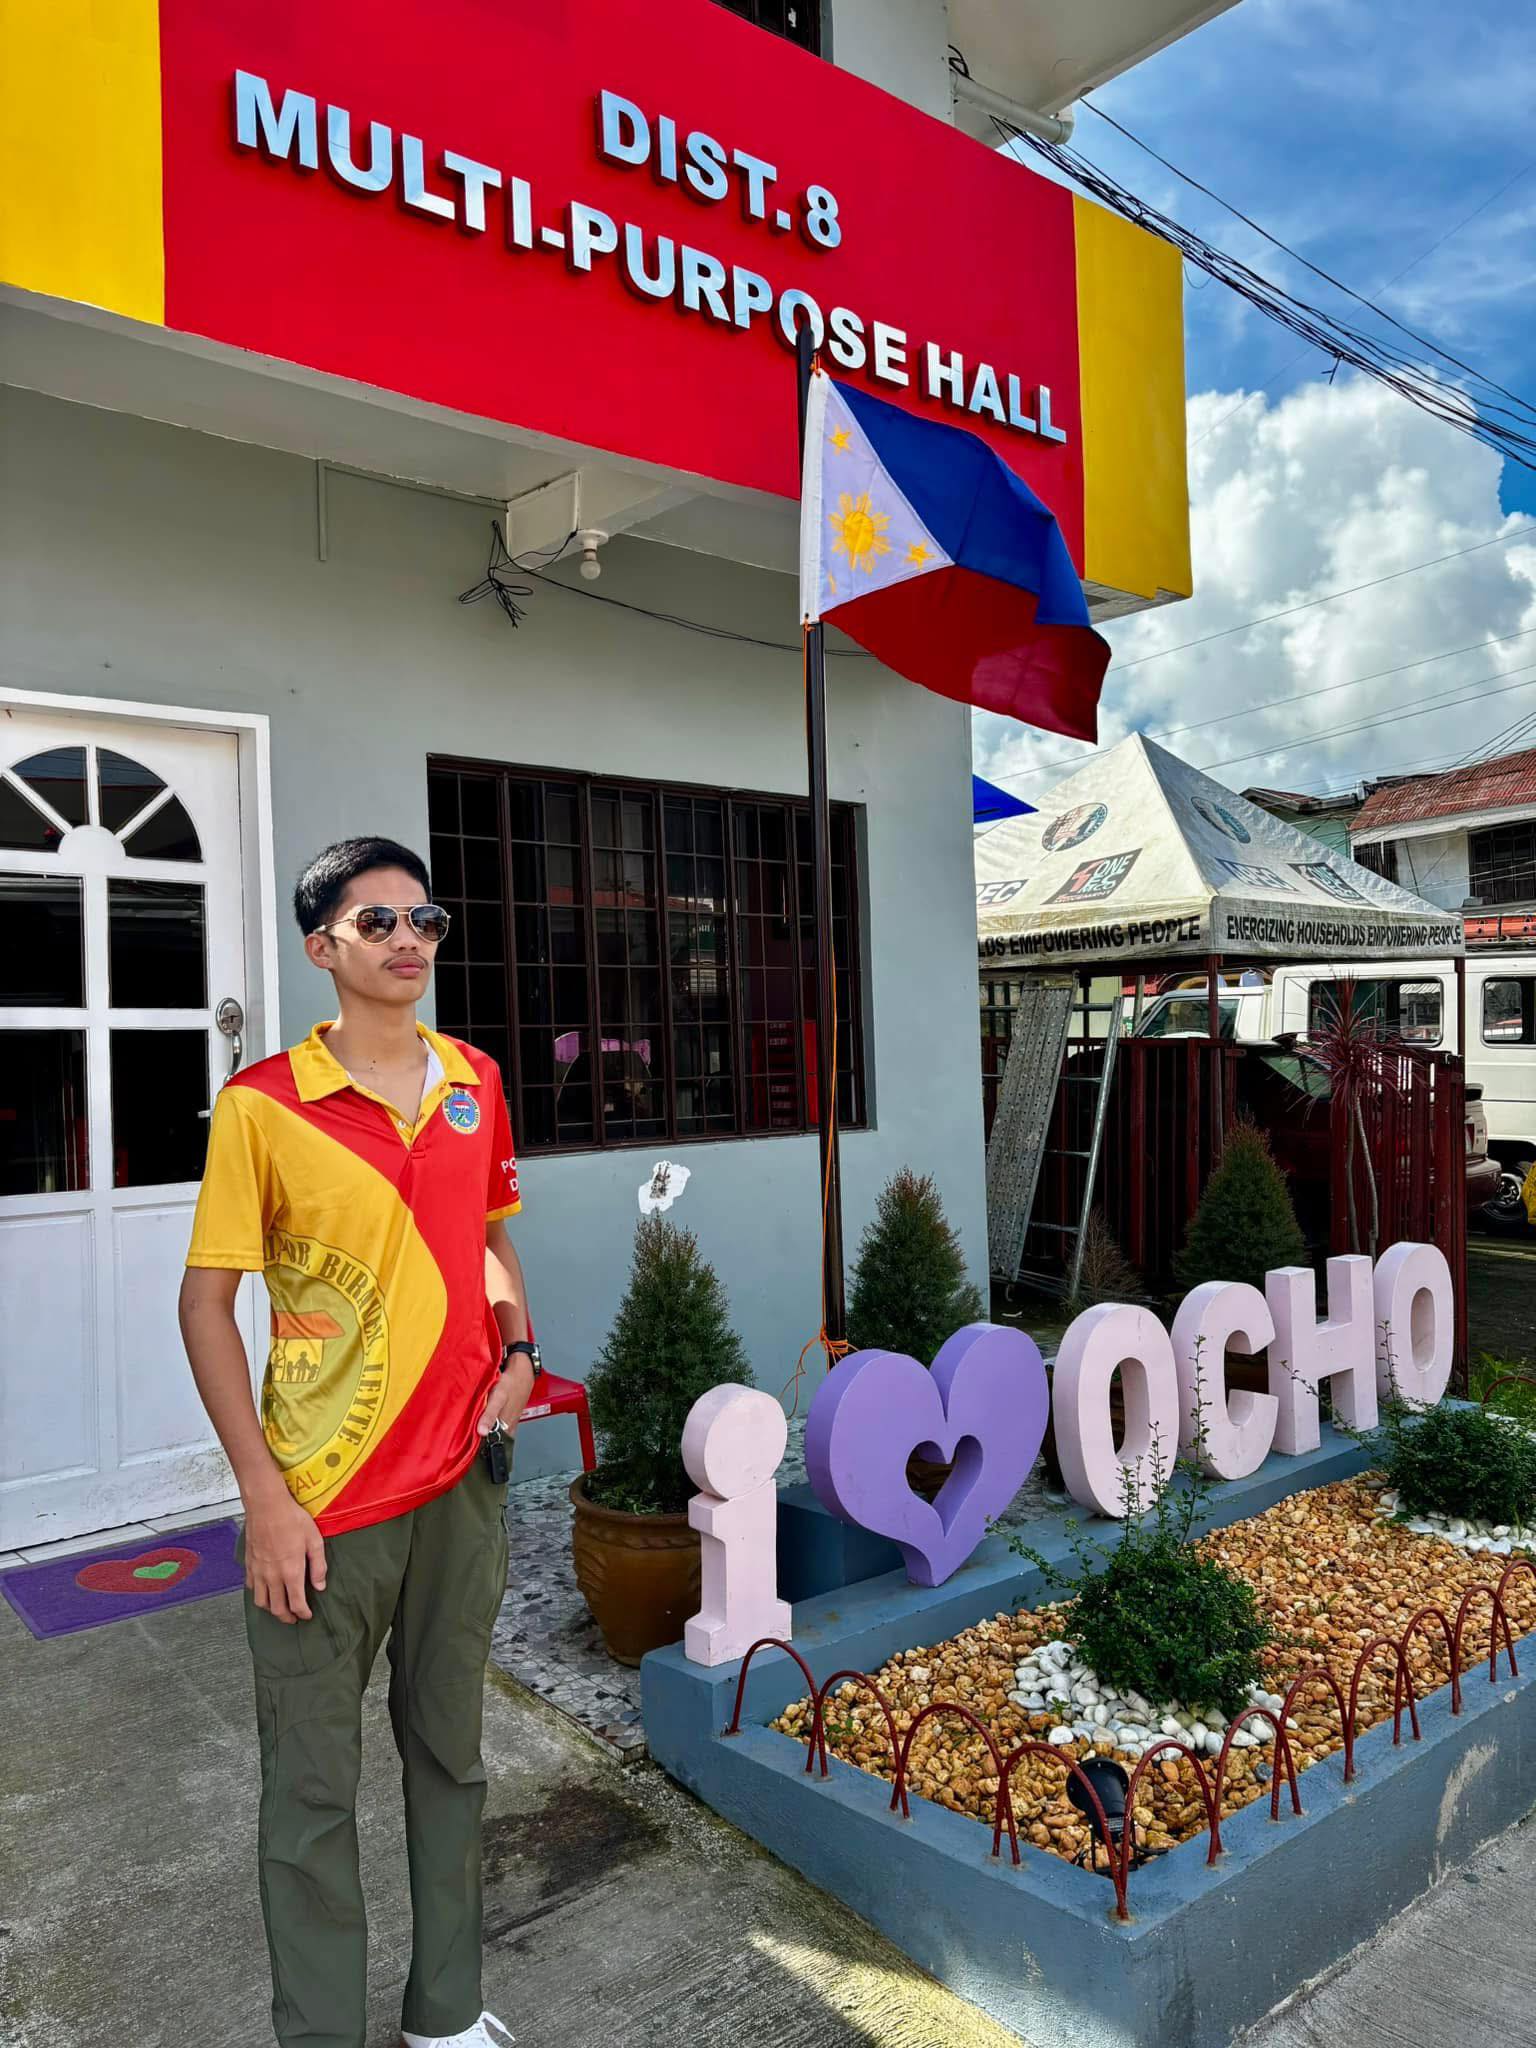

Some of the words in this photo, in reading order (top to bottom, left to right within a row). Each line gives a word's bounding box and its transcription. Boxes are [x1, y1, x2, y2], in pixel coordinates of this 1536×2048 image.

[600, 89, 792, 231] DIST.
[806, 184, 843, 249] 8
[235, 69, 909, 387] MULTI-PURPOSE
[925, 341, 1067, 443] HALL
[1009, 923, 1125, 955] EMPOWERING
[1127, 915, 1201, 946] PEOPLE
[1226, 915, 1295, 944] ENERGIZING
[1297, 920, 1366, 946] HOUSEHOLDS
[1366, 924, 1428, 947] EMPOWERING
[1428, 924, 1462, 946] PEOPLE
[337, 1362, 384, 1446] LEYTE
[1052, 1241, 1454, 1520] OCHO
